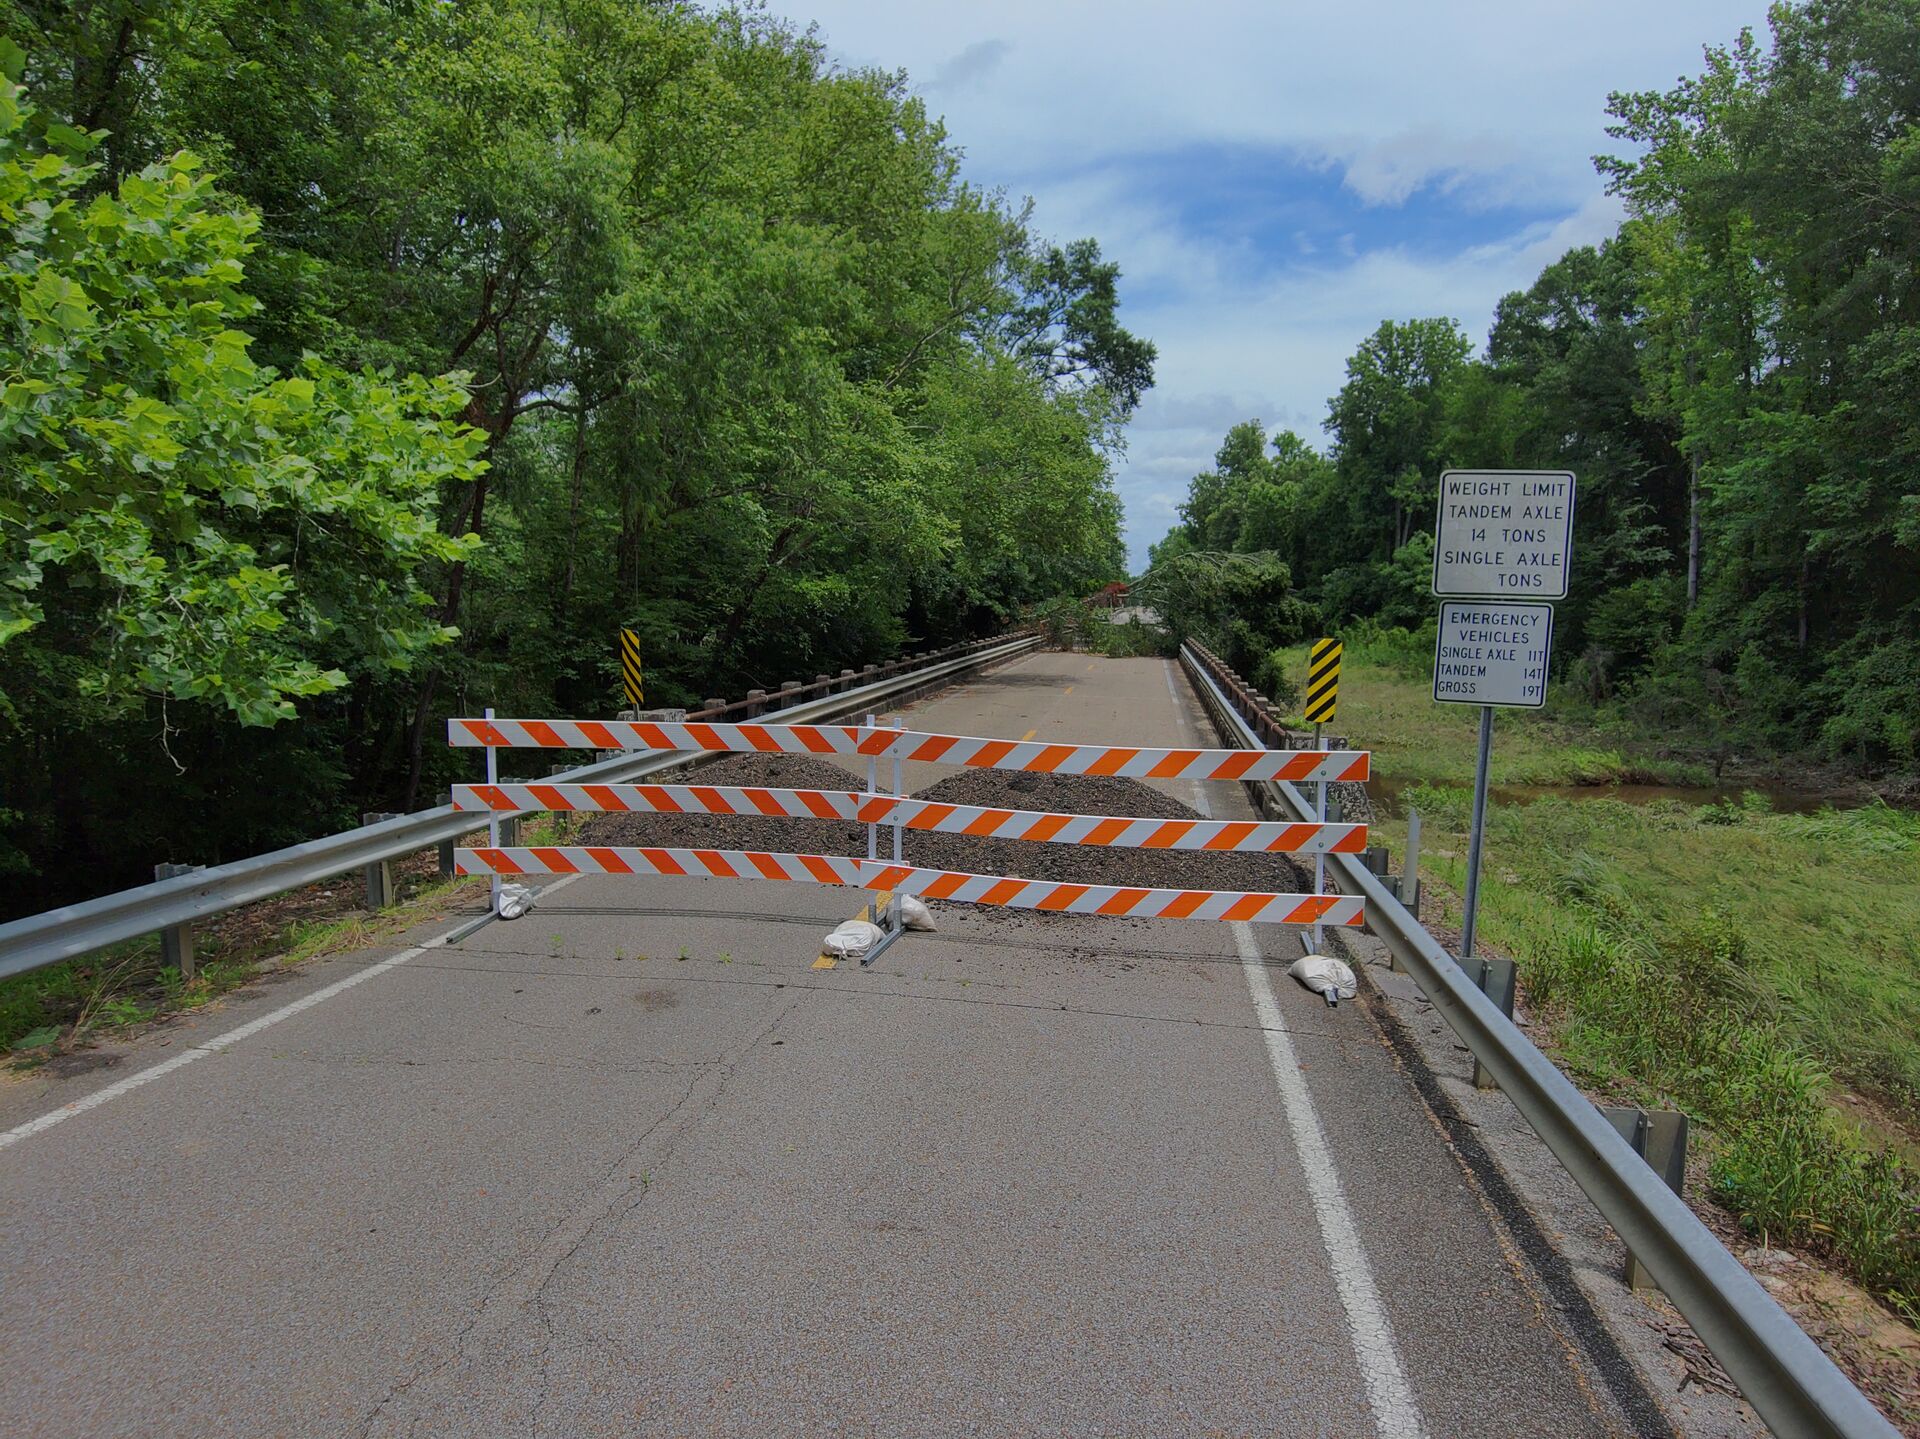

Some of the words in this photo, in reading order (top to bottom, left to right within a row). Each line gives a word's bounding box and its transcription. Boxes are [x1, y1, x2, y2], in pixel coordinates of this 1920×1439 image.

[1449, 483, 1511, 496] WEIGHT
[1523, 484, 1566, 497] LIMIT
[1449, 505, 1511, 518] TANDEM
[1523, 506, 1563, 519] AXLE
[1472, 529, 1486, 541] 14
[1503, 529, 1546, 543] TONS
[1444, 551, 1504, 564] SINGLE
[1517, 553, 1560, 566] AXLE
[1498, 574, 1542, 586] TONS
[1451, 612, 1539, 626] EMERGENCY
[1460, 631, 1529, 644] VEHICLES
[1442, 647, 1481, 659] SINGLE
[1487, 648, 1516, 660] AXLE
[1528, 651, 1544, 662] 11T
[1440, 664, 1486, 677] TANDEM
[1524, 669, 1542, 679] 14T
[1439, 682, 1476, 694] GROSS
[1523, 686, 1540, 697] 19T
